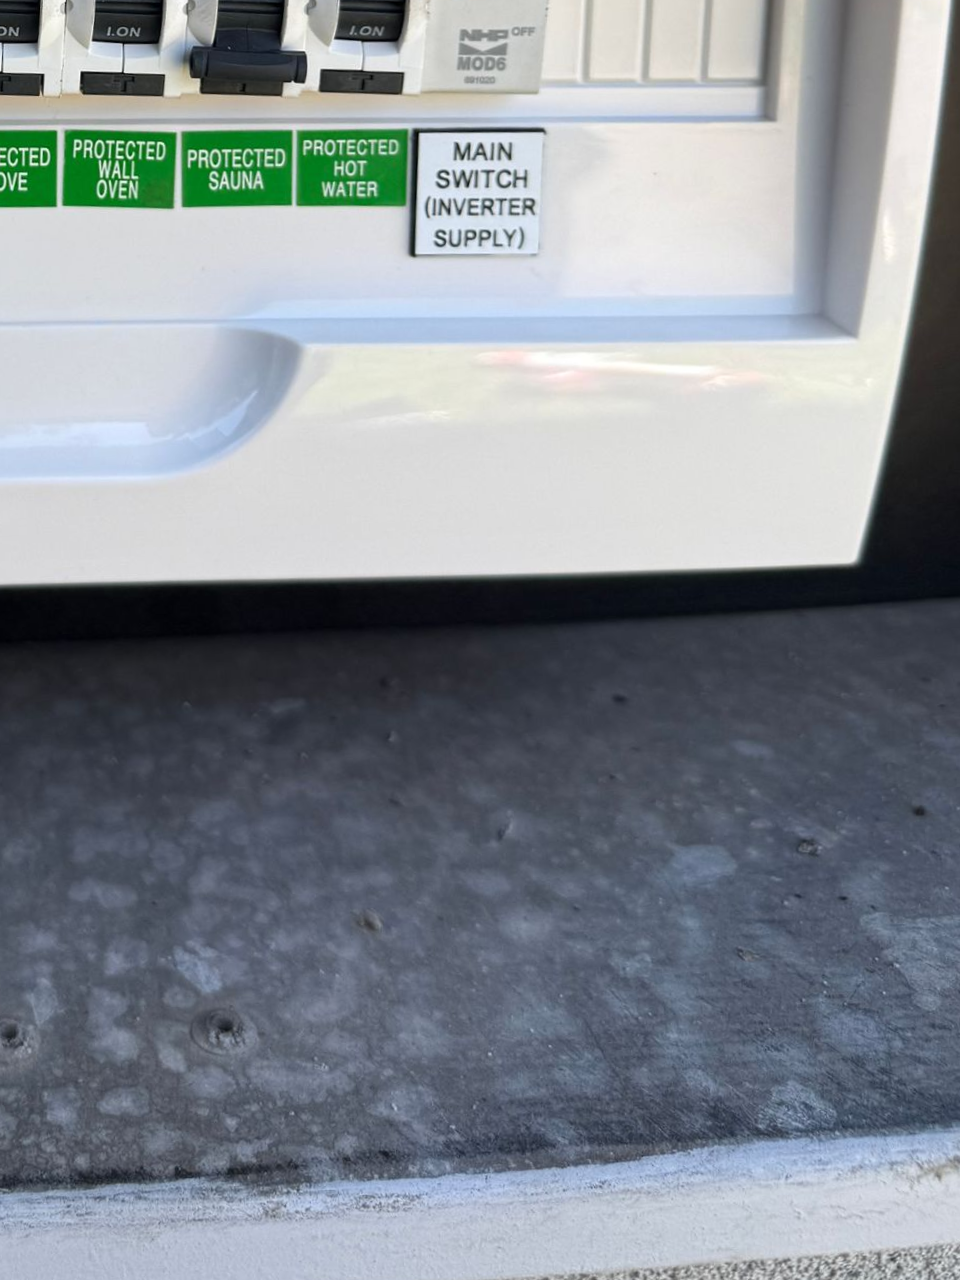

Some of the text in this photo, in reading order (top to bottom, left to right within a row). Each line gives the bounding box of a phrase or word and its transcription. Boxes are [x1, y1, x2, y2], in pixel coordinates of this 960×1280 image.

[459, 29, 509, 42] NHP
[511, 27, 536, 36] OFF
[456, 56, 507, 71] MOD6
[72, 139, 167, 161] PROTECTED
[302, 139, 400, 156] PROTECTED
[452, 141, 514, 162] MAIN
[186, 148, 287, 170] PROTECTED
[333, 160, 368, 177] HOT
[97, 160, 140, 180] WALL
[435, 169, 529, 189] SWITCH
[95, 180, 139, 200] OVEN
[208, 171, 265, 191] SAUNA
[321, 181, 379, 198] WATER
[424, 195, 537, 219] (INVERTER
[433, 226, 525, 249] SUPPLY)
